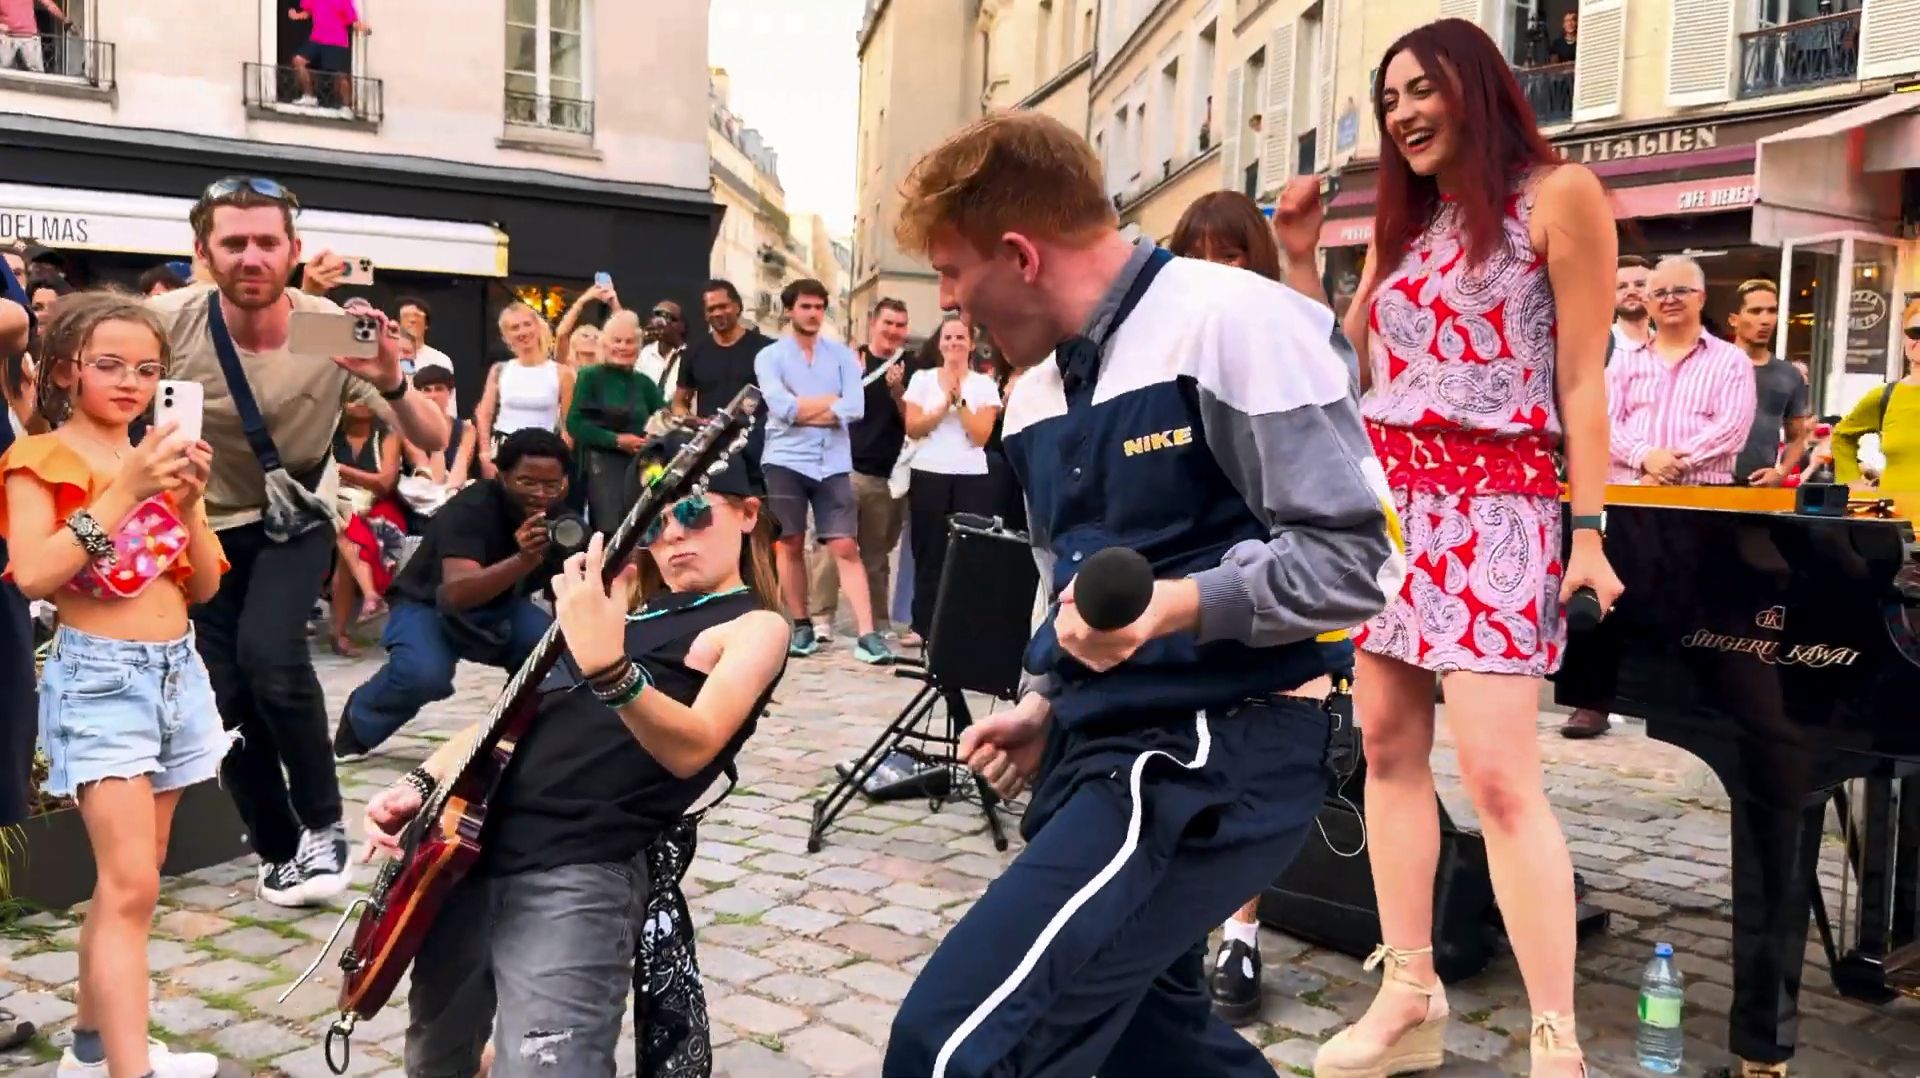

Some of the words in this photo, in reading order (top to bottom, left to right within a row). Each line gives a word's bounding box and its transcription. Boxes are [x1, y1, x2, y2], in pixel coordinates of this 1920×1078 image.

[1582, 126, 1717, 164] ITALIEN
[0, 213, 88, 243] DELMAS
[1123, 425, 1193, 457] NIKE
[1681, 628, 1781, 665] SHIGERU
[1776, 643, 1861, 668] KAWAI
